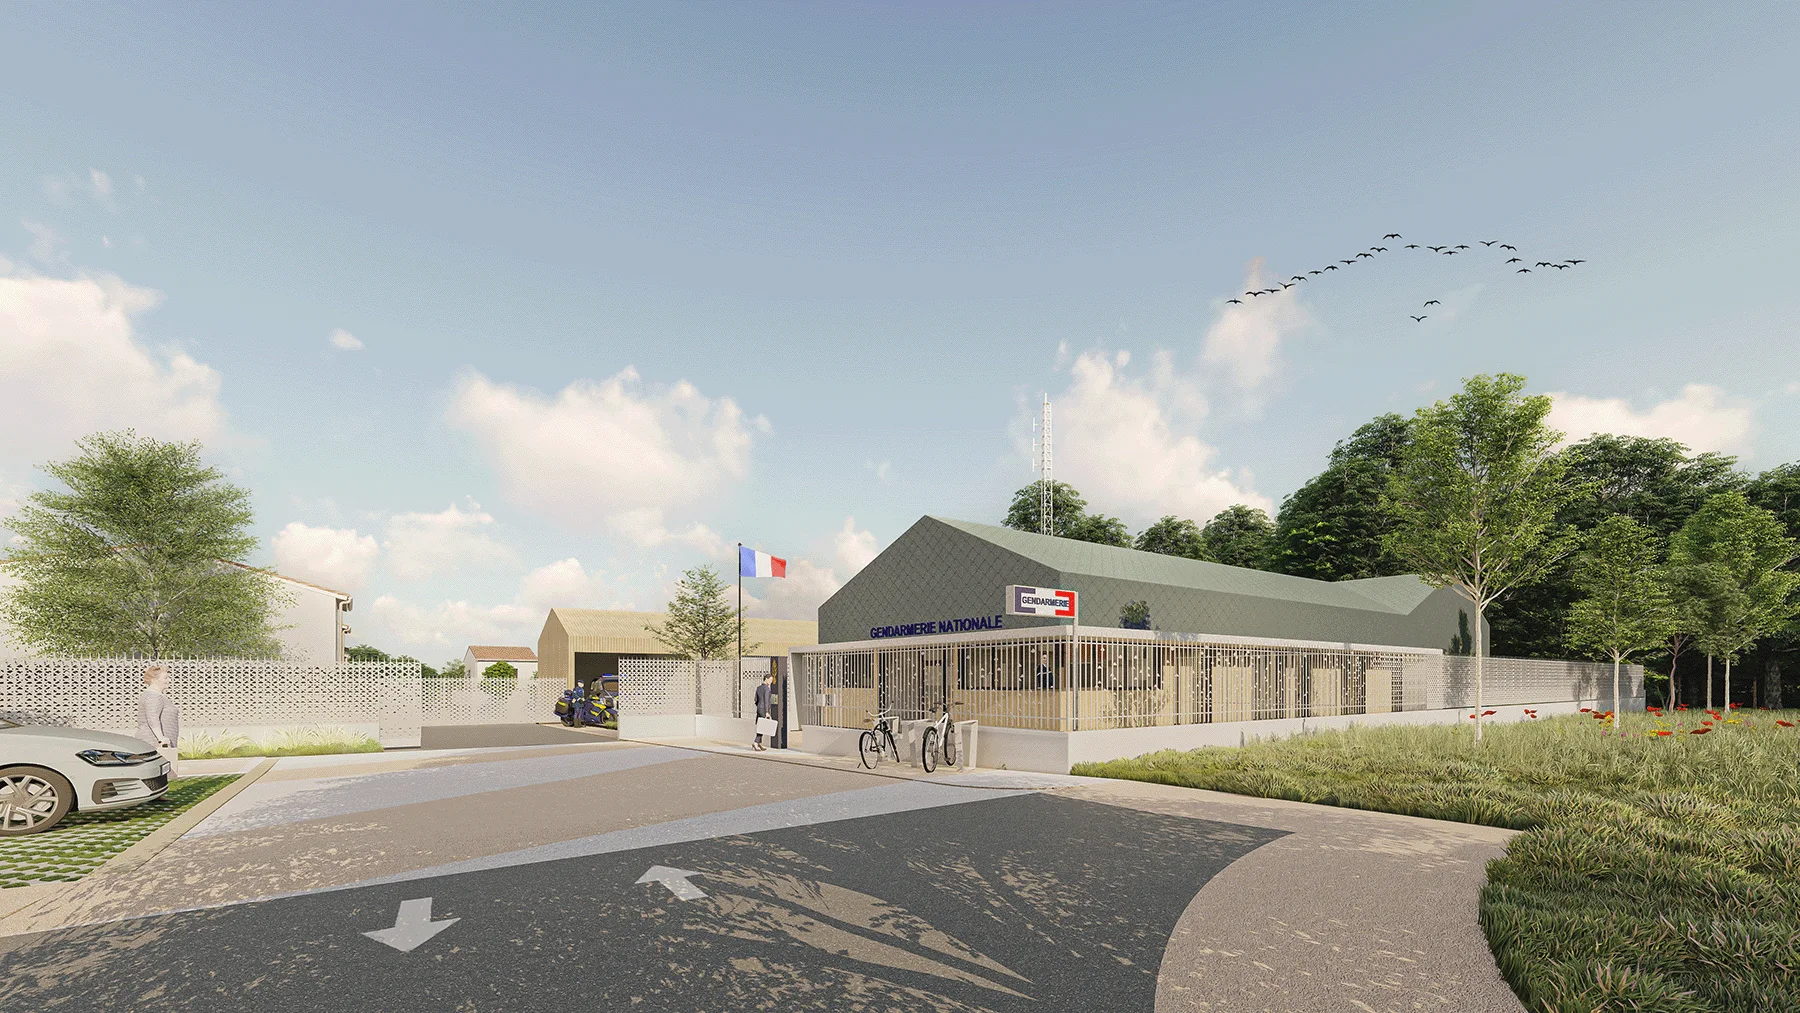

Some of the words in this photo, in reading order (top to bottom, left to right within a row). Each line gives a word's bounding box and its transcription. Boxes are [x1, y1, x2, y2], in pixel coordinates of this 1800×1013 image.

[1022, 596, 1070, 607] GENDARMERIE
[870, 621, 937, 639] GENDARMERIE
[938, 615, 1003, 633] NATIONALE
